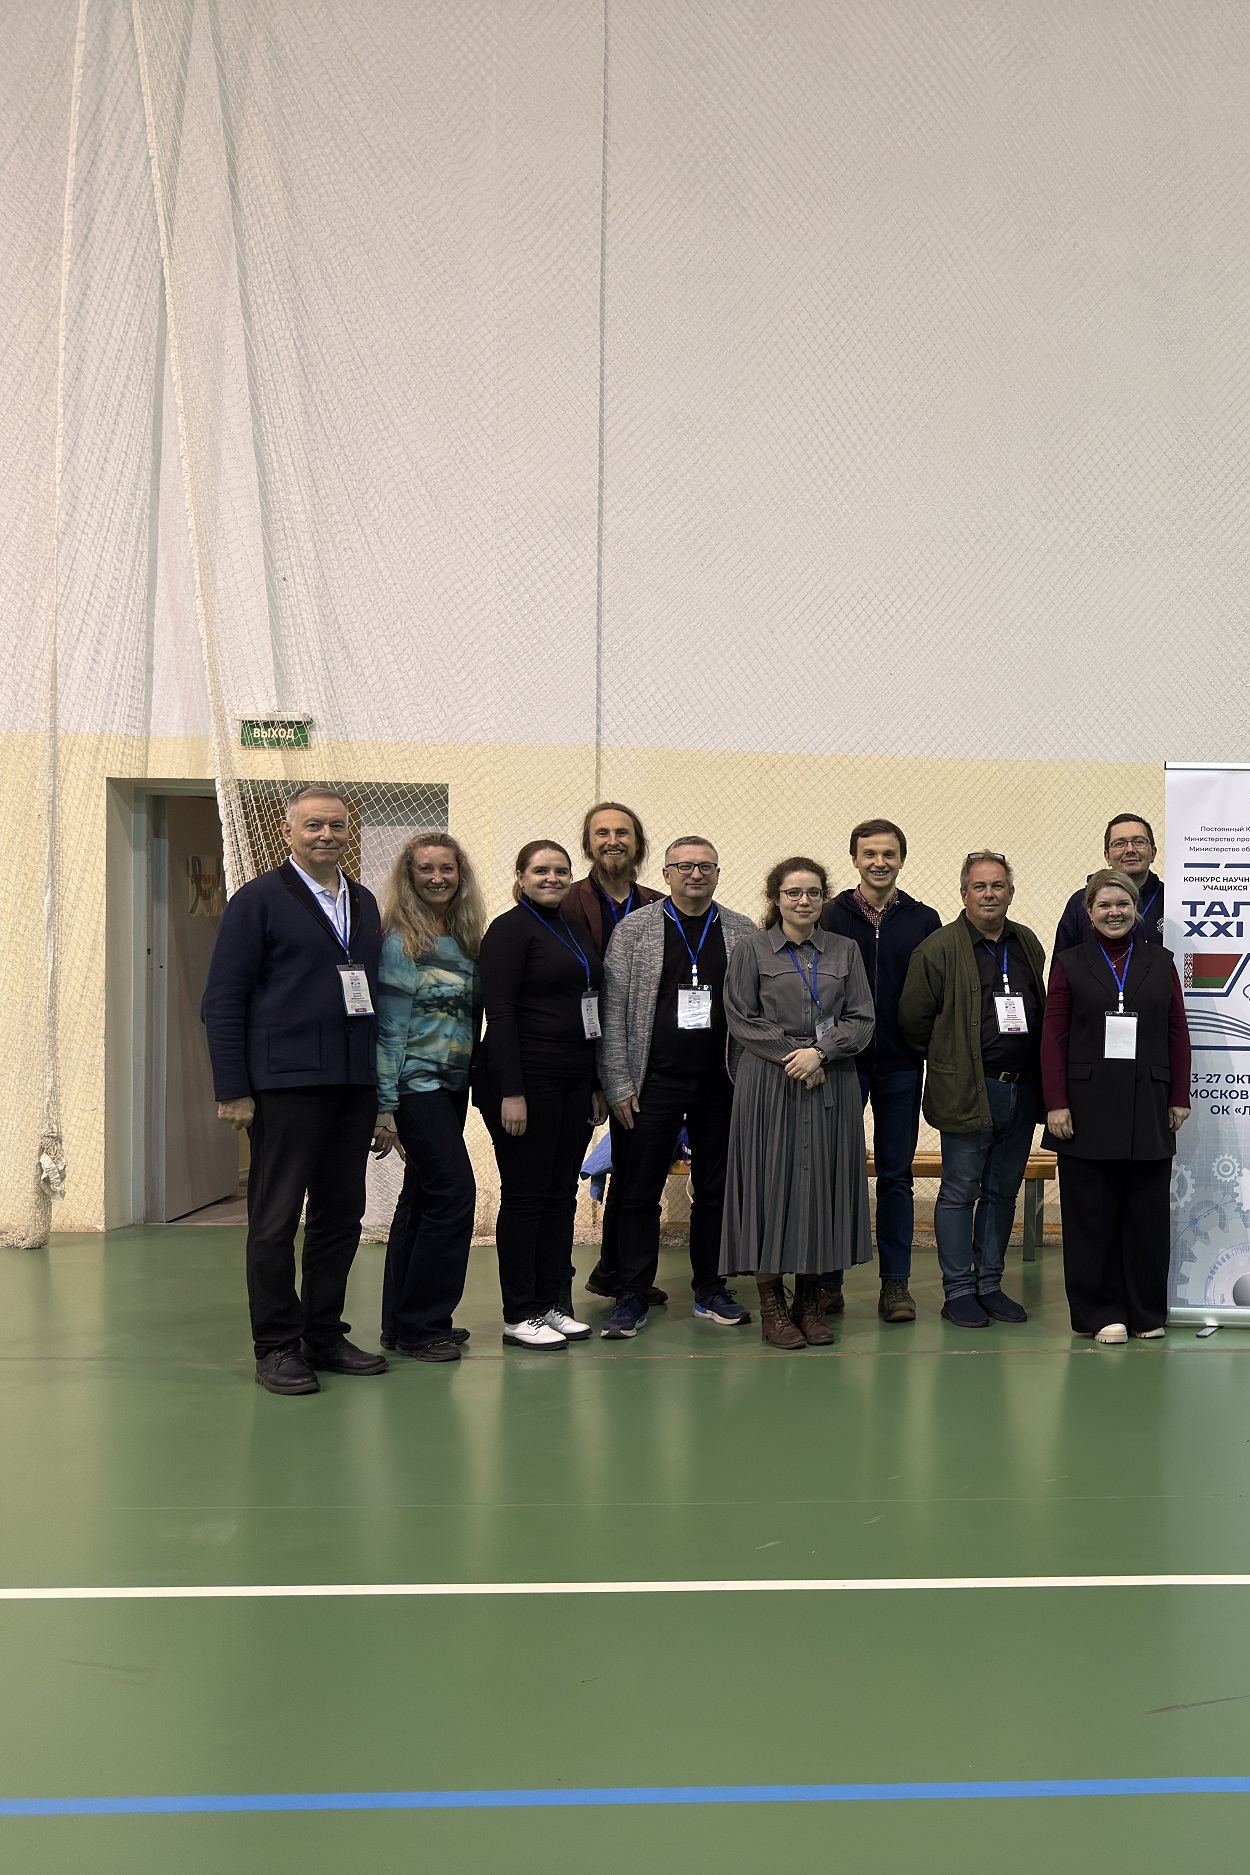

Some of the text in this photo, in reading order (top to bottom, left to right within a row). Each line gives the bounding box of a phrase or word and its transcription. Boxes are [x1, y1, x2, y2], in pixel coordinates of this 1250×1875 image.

[253, 727, 294, 739] ВЫХОД
[1183, 921, 1244, 937] XXI
[1191, 1073, 1221, 1083] 3–27
[1210, 1105, 1230, 1115] ОК
